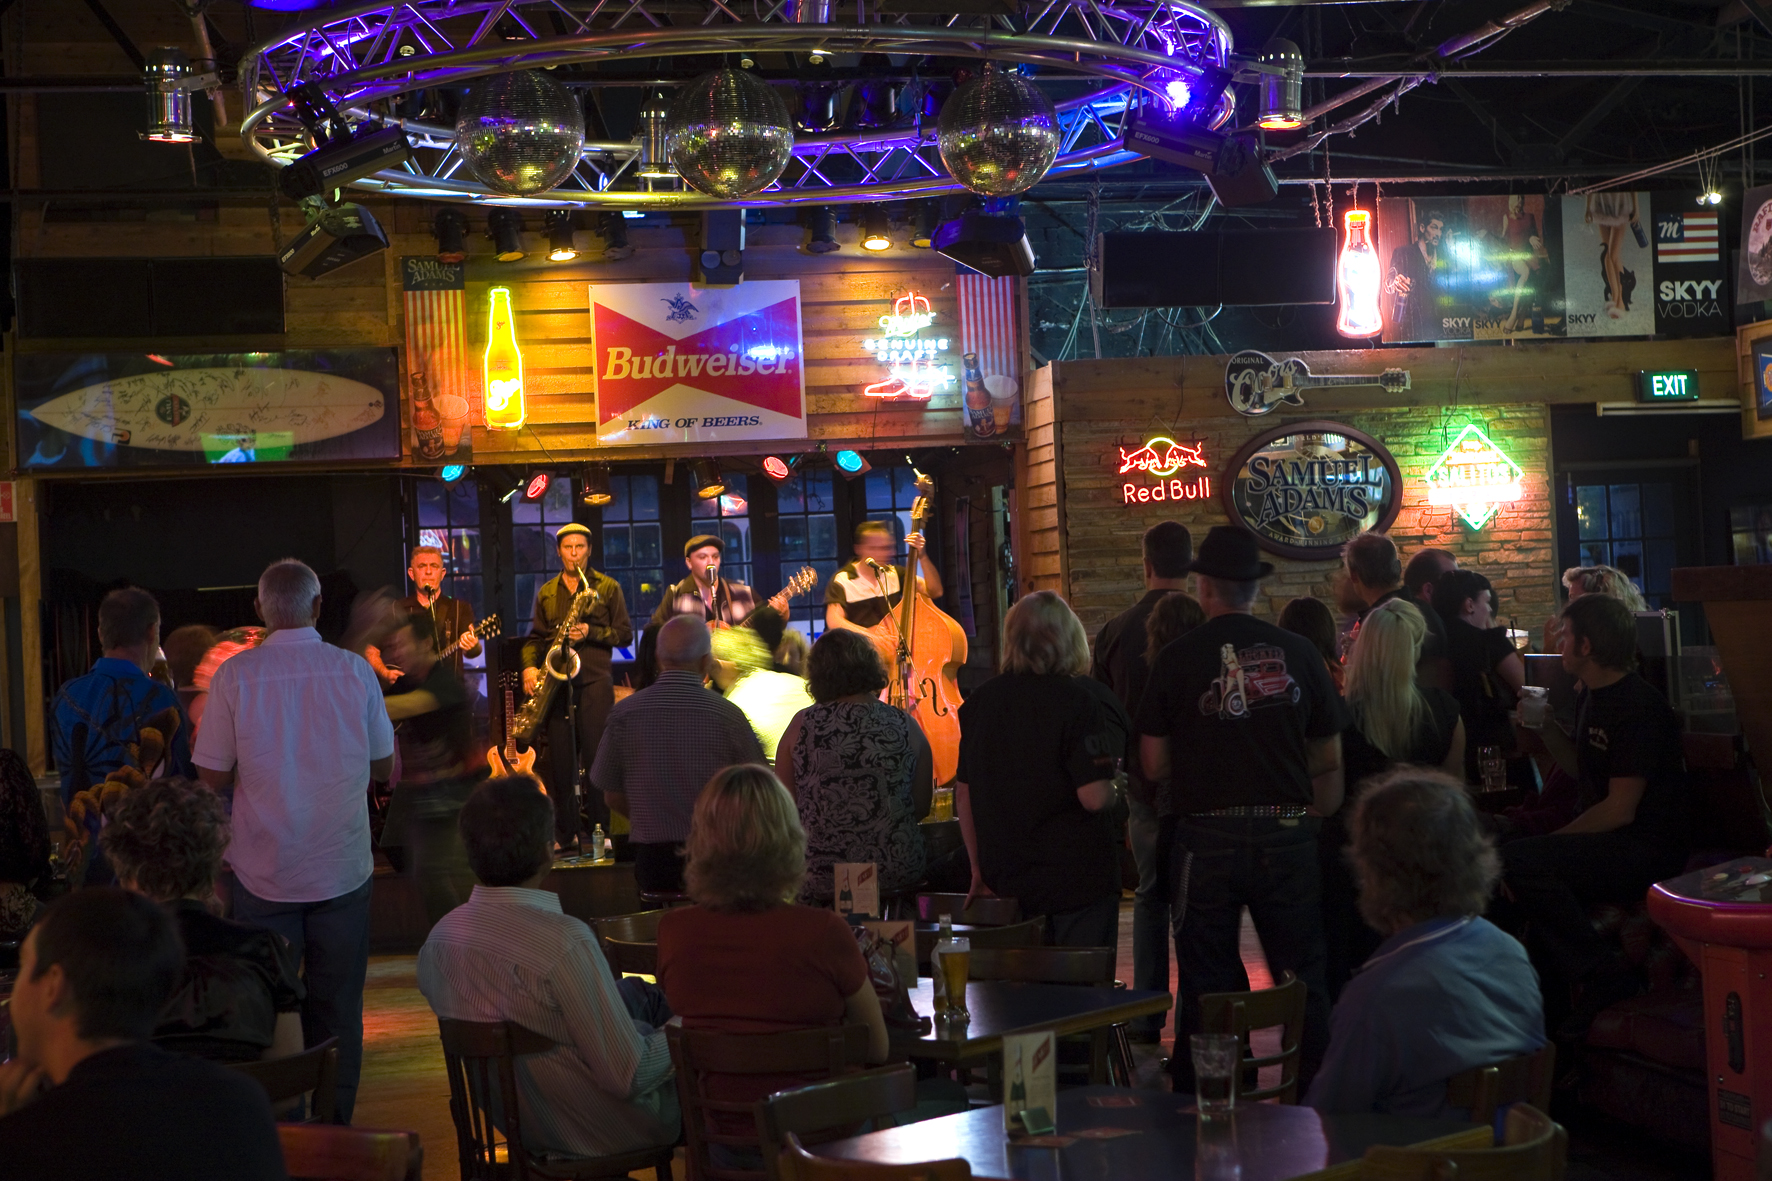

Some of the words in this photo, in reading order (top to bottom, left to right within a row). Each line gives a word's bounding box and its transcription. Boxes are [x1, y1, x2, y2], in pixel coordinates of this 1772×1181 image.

[1134, 131, 1160, 144] EFX600
[407, 258, 461, 273] SAMUEL
[410, 269, 456, 286] ADAMS
[1659, 279, 1723, 301] SKYY
[1657, 301, 1723, 319] VODKA
[1442, 316, 1471, 328] SKYY
[1475, 319, 1501, 329] SKYY
[1567, 313, 1597, 324] SKYY
[601, 343, 796, 381] Budweiser
[877, 349, 938, 362] DRAFT
[1231, 356, 1265, 365] ORIGINAL
[1652, 374, 1688, 396] EXIT
[626, 417, 671, 431] KING
[674, 417, 699, 429] OF
[1246, 453, 1384, 494] SAMUEL
[1123, 479, 1166, 504] Red
[1169, 476, 1210, 500] Bull
[1255, 486, 1369, 530] ADAMS
